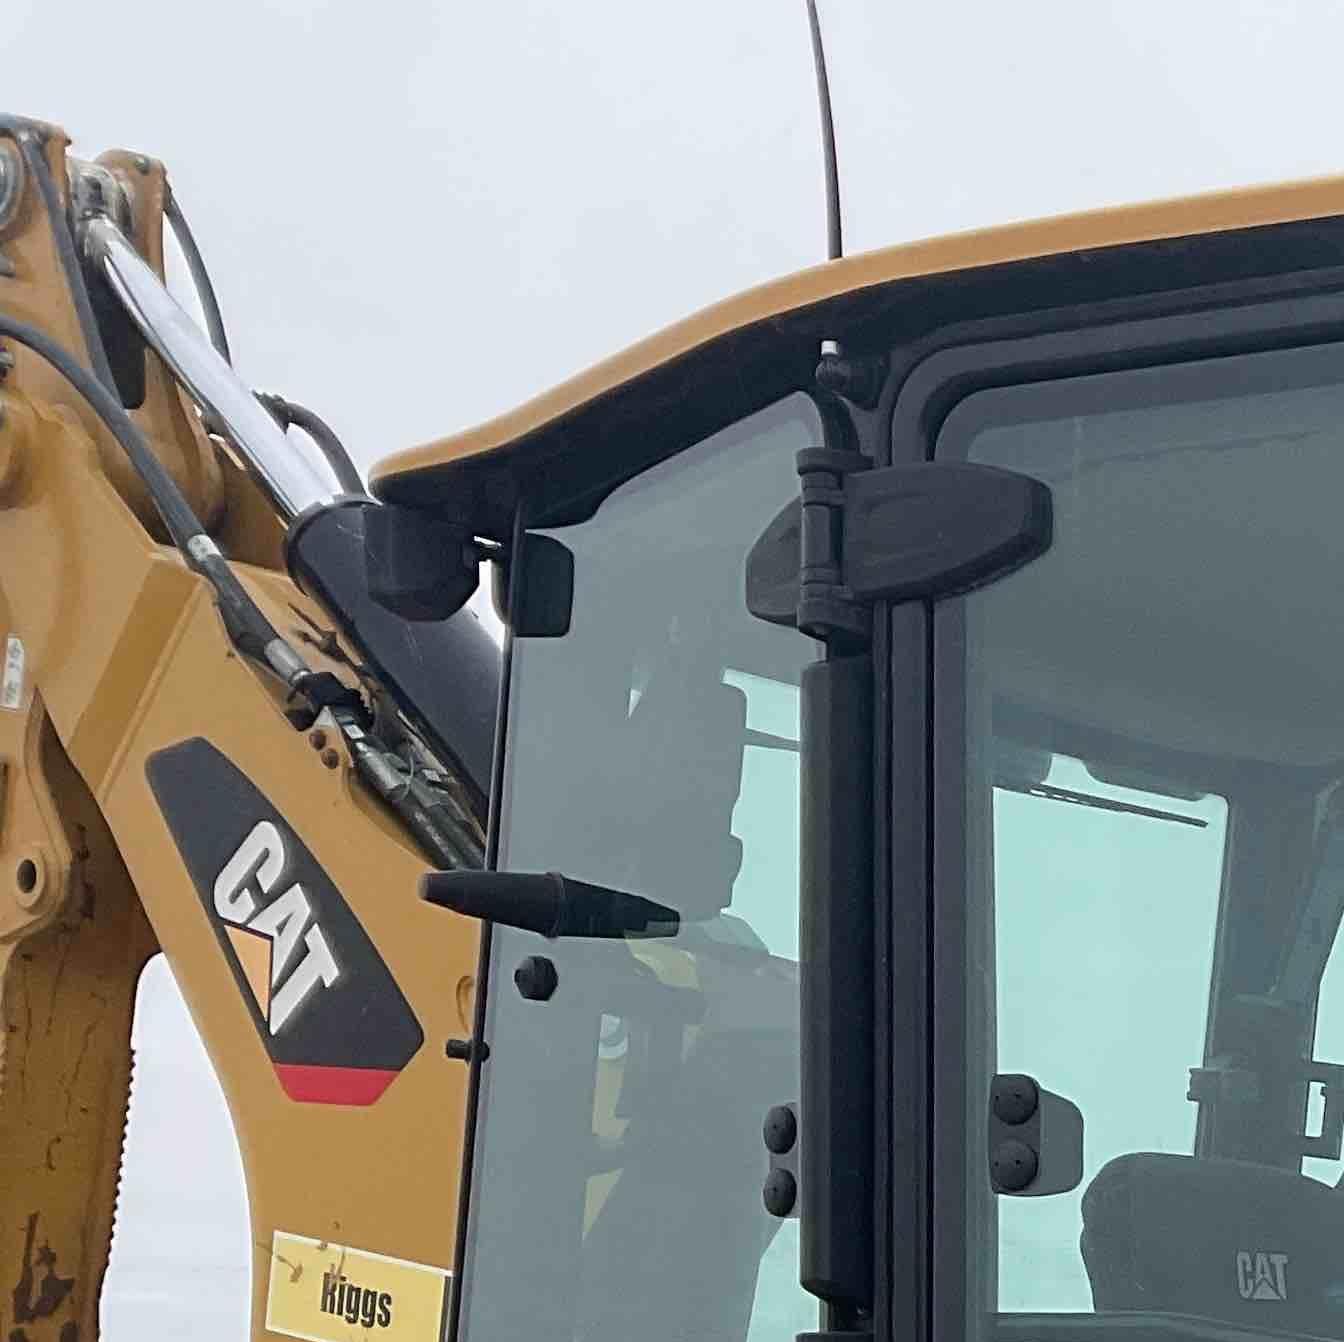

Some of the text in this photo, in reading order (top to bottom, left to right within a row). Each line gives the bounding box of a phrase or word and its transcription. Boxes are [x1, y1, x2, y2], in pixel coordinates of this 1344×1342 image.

[213, 819, 340, 1037] CAT
[320, 1271, 393, 1329] Riggs
[1236, 1250, 1290, 1300] CAT
